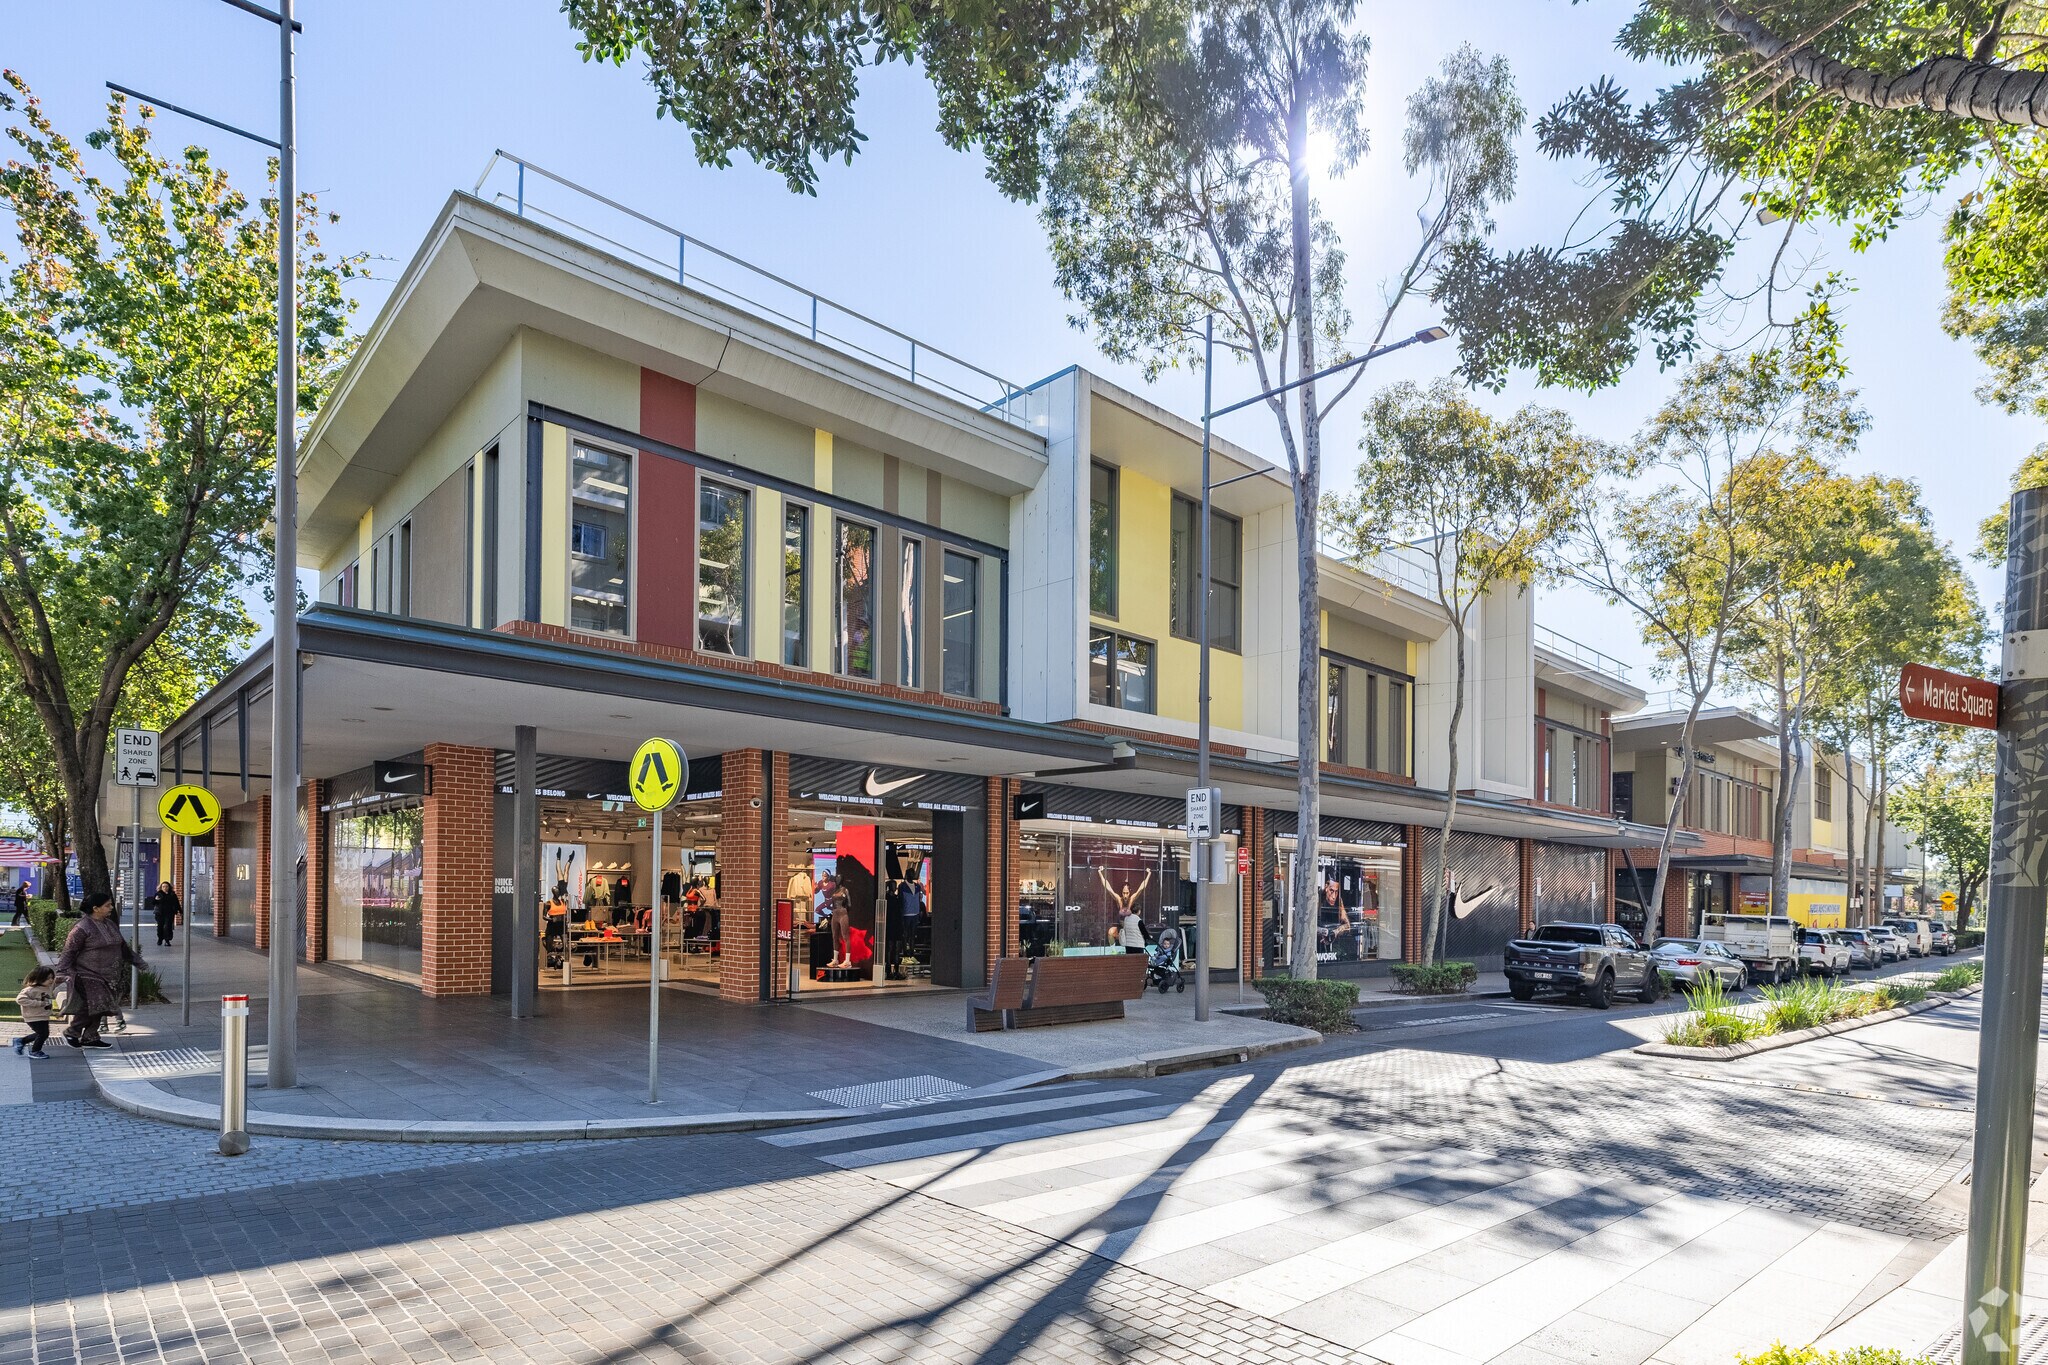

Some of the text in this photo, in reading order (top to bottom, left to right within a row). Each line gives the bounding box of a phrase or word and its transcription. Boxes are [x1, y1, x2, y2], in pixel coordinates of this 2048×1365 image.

[1923, 678, 1993, 721] Market Square
[124, 734, 152, 746] END
[122, 748, 153, 757] SHARED
[128, 757, 147, 765] ZONE
[502, 786, 513, 794] ALL
[542, 789, 565, 797] BELONG
[606, 794, 631, 802] WELCOME
[1190, 793, 1207, 803] END
[1113, 843, 1140, 856] JUST
[495, 878, 513, 886] NIKE
[495, 886, 514, 894] ROUS
[777, 929, 792, 939] SALE
[1316, 951, 1338, 961] WORK
[1511, 960, 1576, 970] RANGER
